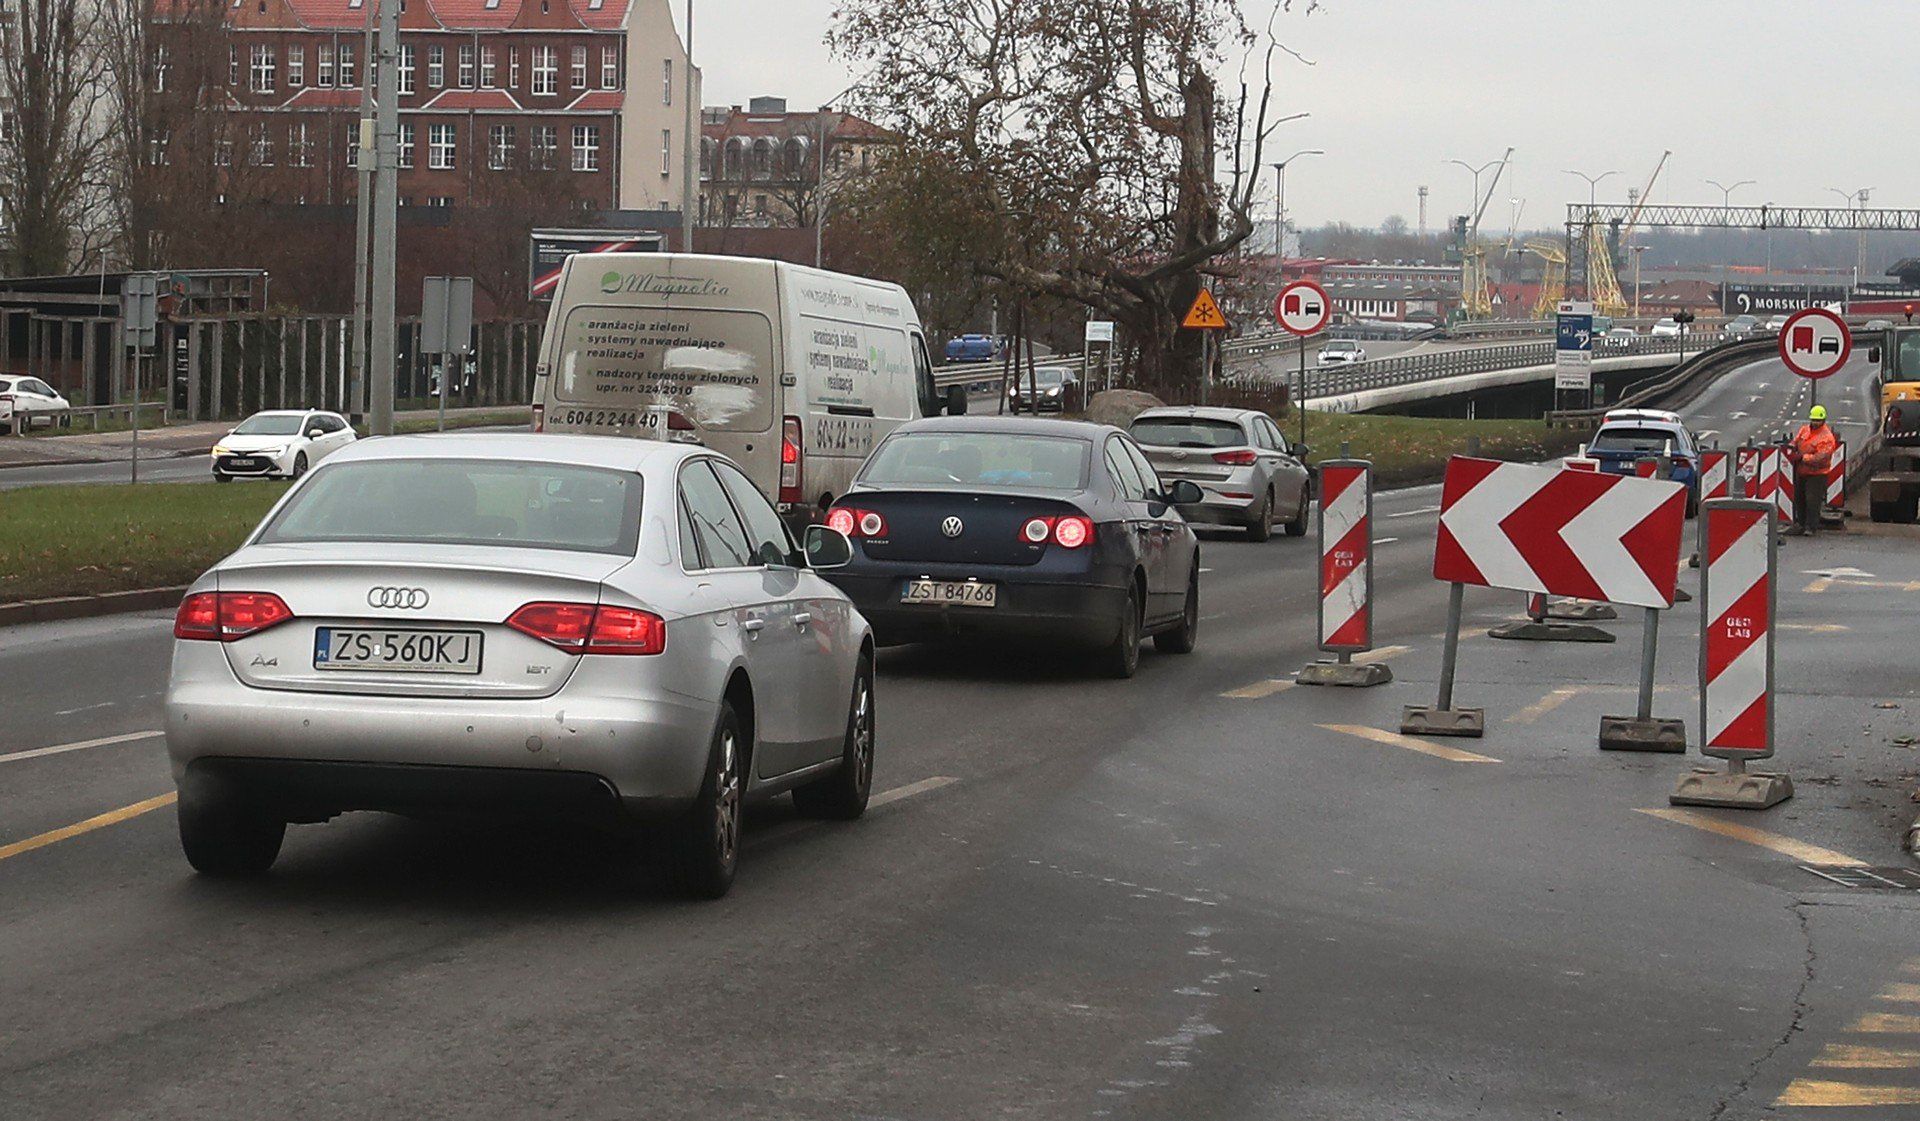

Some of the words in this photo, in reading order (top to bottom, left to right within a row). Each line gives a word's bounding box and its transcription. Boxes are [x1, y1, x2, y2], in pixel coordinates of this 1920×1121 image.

[625, 272, 730, 300] Magnolia
[1755, 298, 1807, 310] MORSKIE
[588, 321, 646, 332] aranżacja
[649, 322, 690, 332] zieleni
[588, 335, 637, 346] systemy
[640, 337, 725, 350] nawadniające
[587, 349, 645, 360] realizacja
[596, 369, 643, 380] nadzory
[647, 370, 697, 381] terenów
[700, 373, 760, 386] zielonych
[596, 384, 618, 394] upr.
[621, 384, 635, 392] nr
[637, 384, 693, 395] 324/2010
[910, 582, 942, 599] ZST
[945, 583, 994, 601] 84766
[1726, 617, 1751, 627] GEO
[1727, 627, 1751, 638] LAB
[335, 633, 372, 661] ZS
[383, 634, 471, 664] 560KJ
